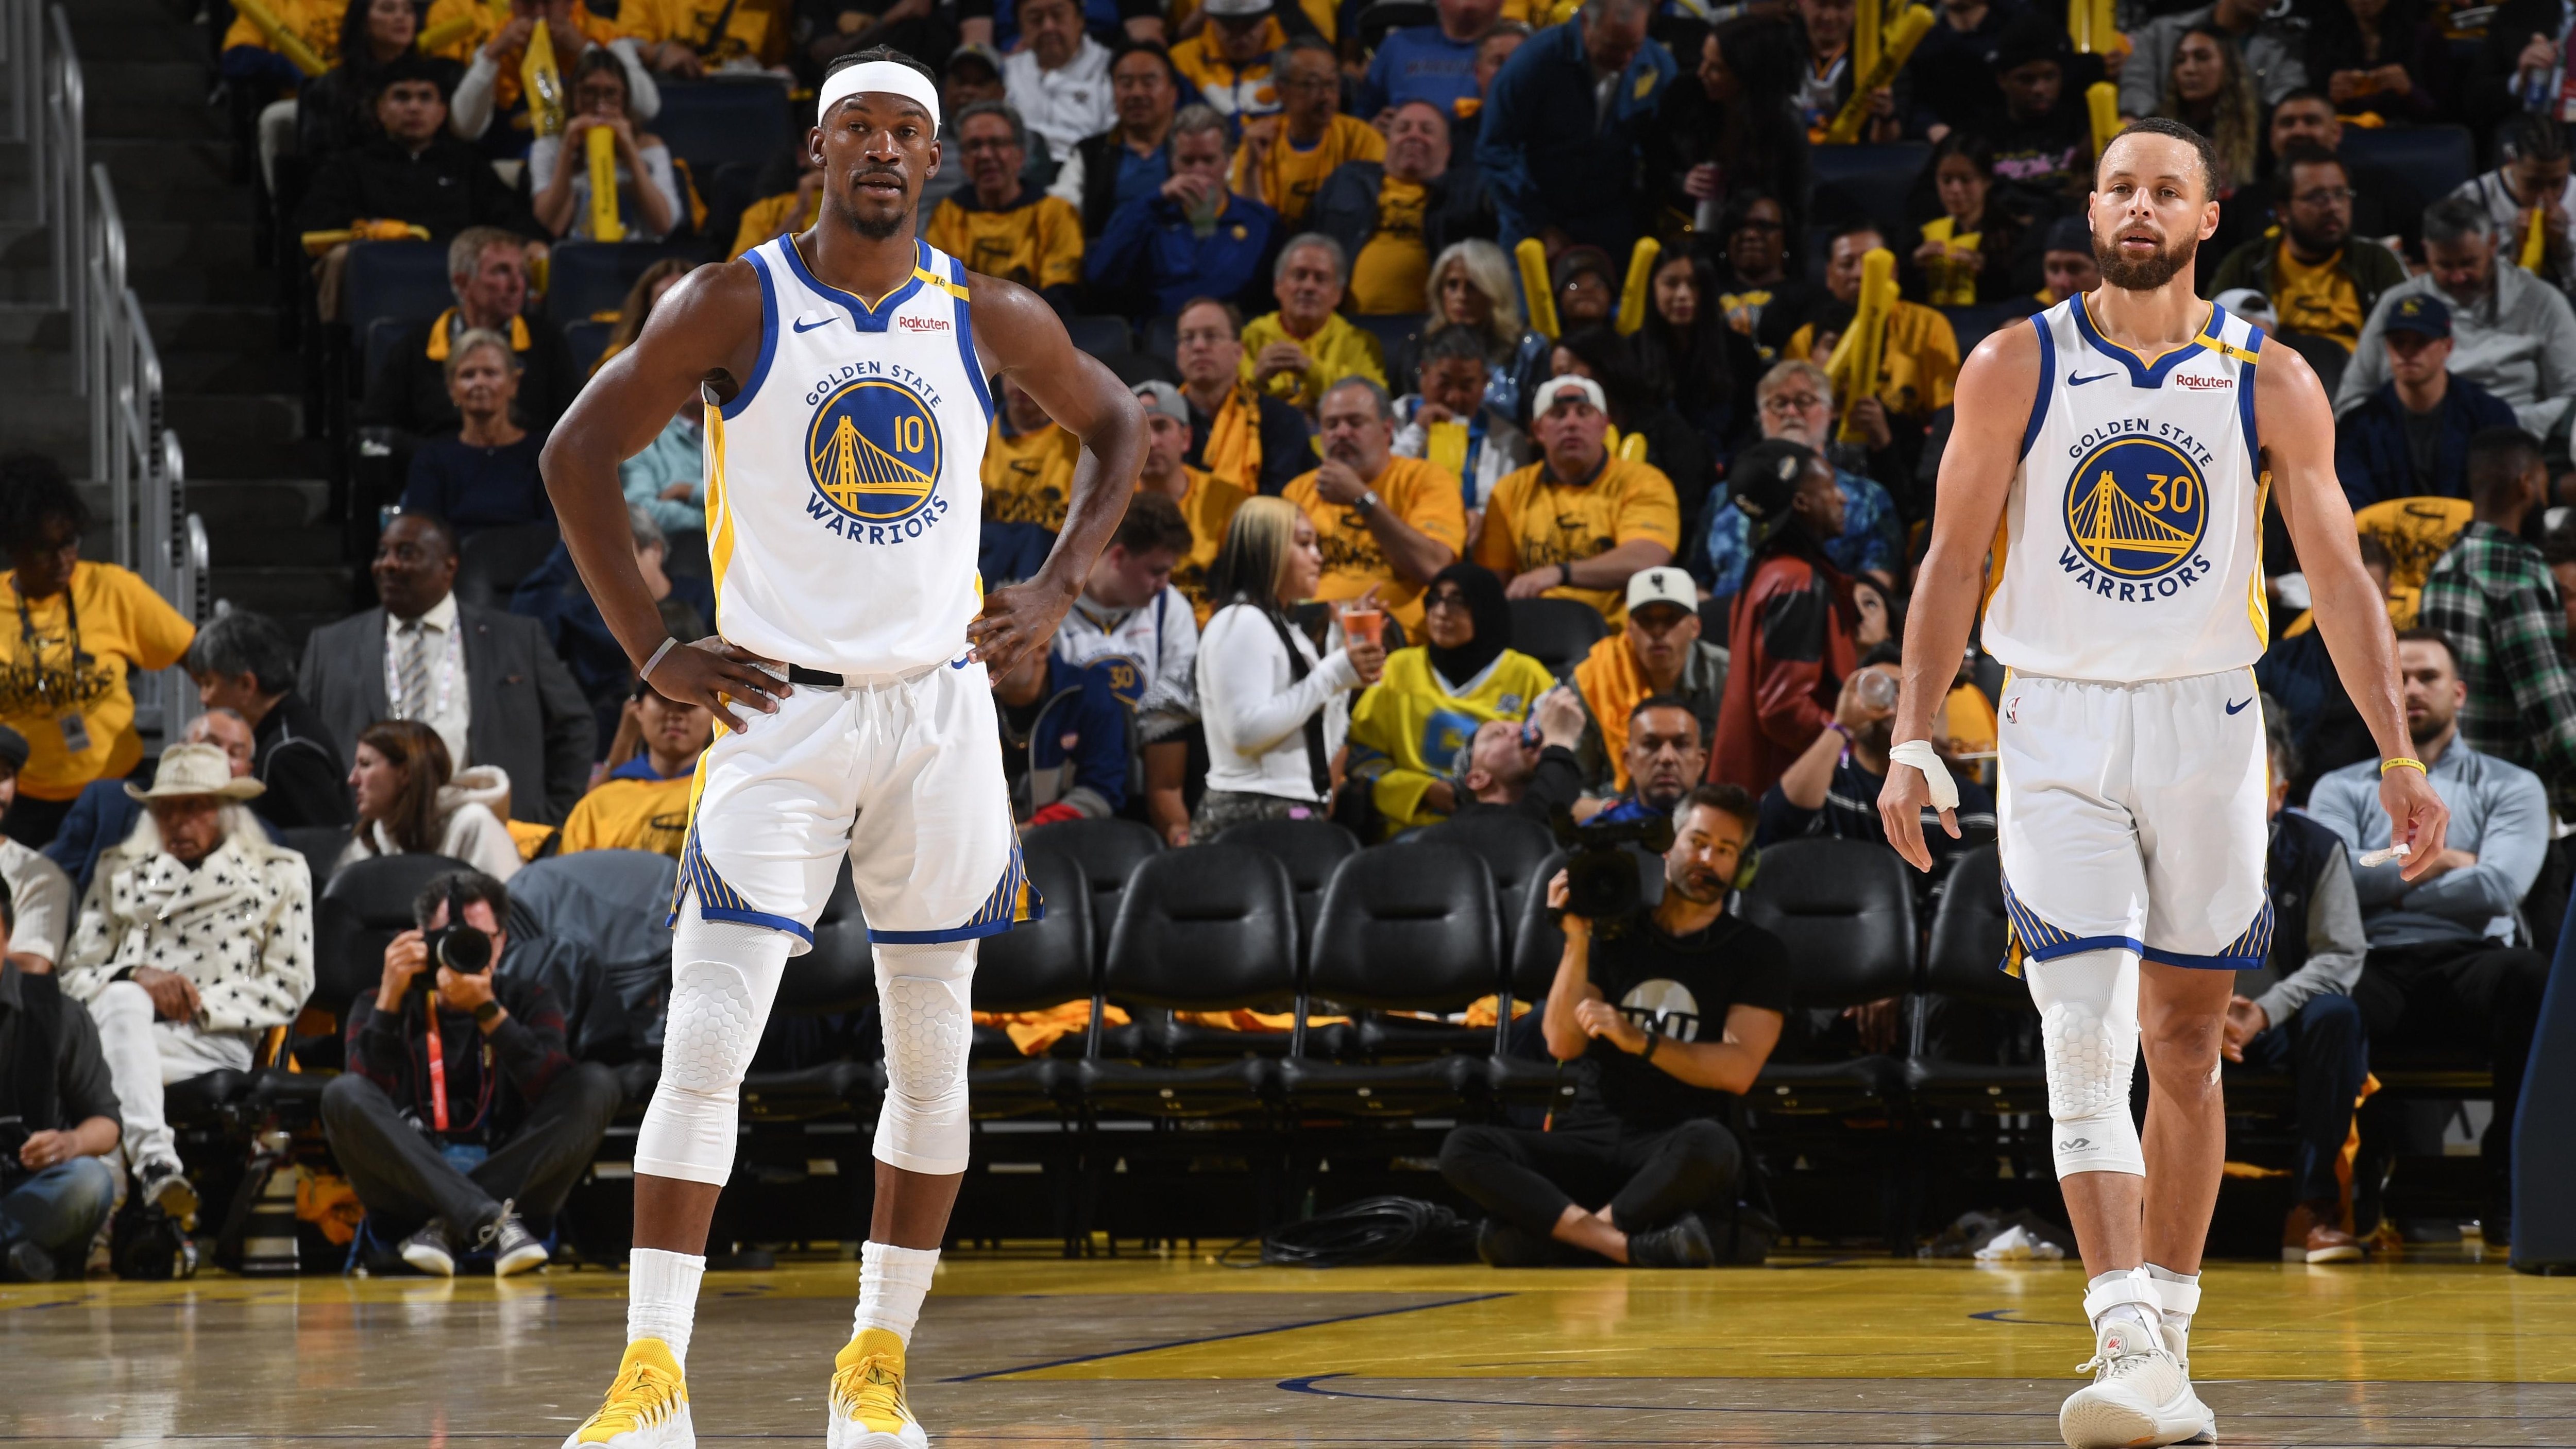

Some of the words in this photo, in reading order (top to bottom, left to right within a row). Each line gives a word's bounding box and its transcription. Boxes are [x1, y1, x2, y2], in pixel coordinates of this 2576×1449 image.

[934, 276, 946, 287] 16
[899, 316, 950, 331] Rakuten
[2221, 344, 2234, 354] 16
[806, 361, 881, 406] GOLDEN
[891, 365, 941, 408] STATE
[2176, 374, 2233, 389] Rakuten
[895, 416, 924, 453] 10
[2069, 418, 2149, 458] GOLDEN
[2159, 423, 2214, 467] STATE
[2144, 474, 2193, 513] 30
[806, 491, 948, 545] WARRIORS
[2059, 544, 2211, 603] WARRIORS
[1109, 665, 1135, 689] 30
